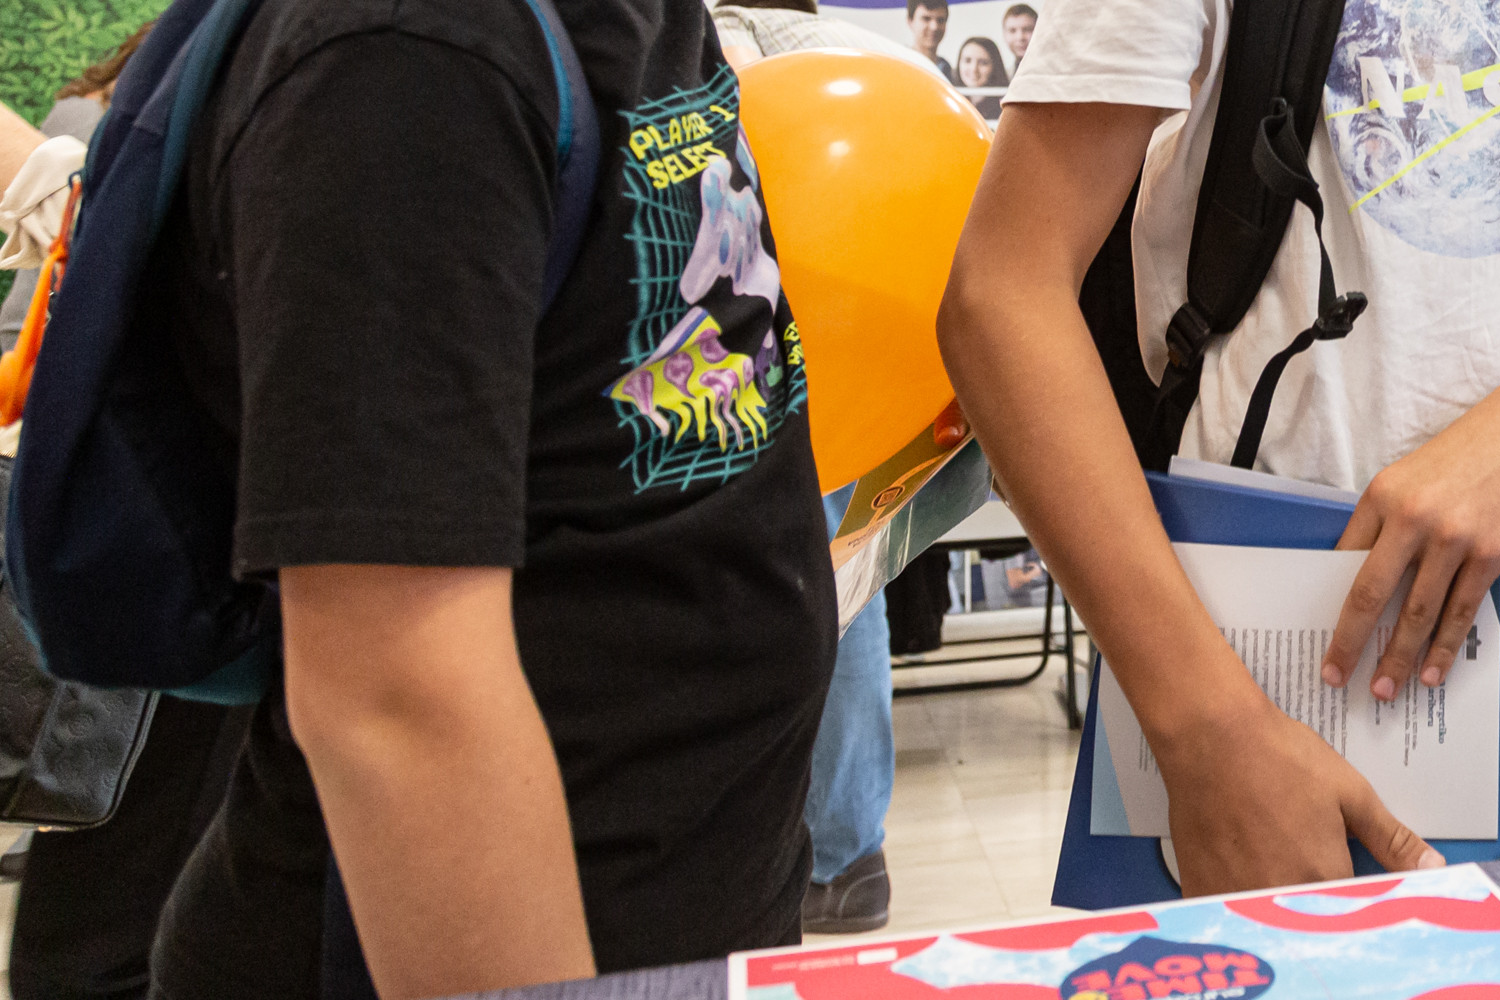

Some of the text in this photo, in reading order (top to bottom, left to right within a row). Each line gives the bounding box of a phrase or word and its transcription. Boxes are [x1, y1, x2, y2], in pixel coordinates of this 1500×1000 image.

[629, 105, 736, 160] PLAYER 1
[646, 141, 727, 189] SELECT
[1427, 686, 1436, 727] ariboru
[1072, 953, 1259, 990] MOVE
